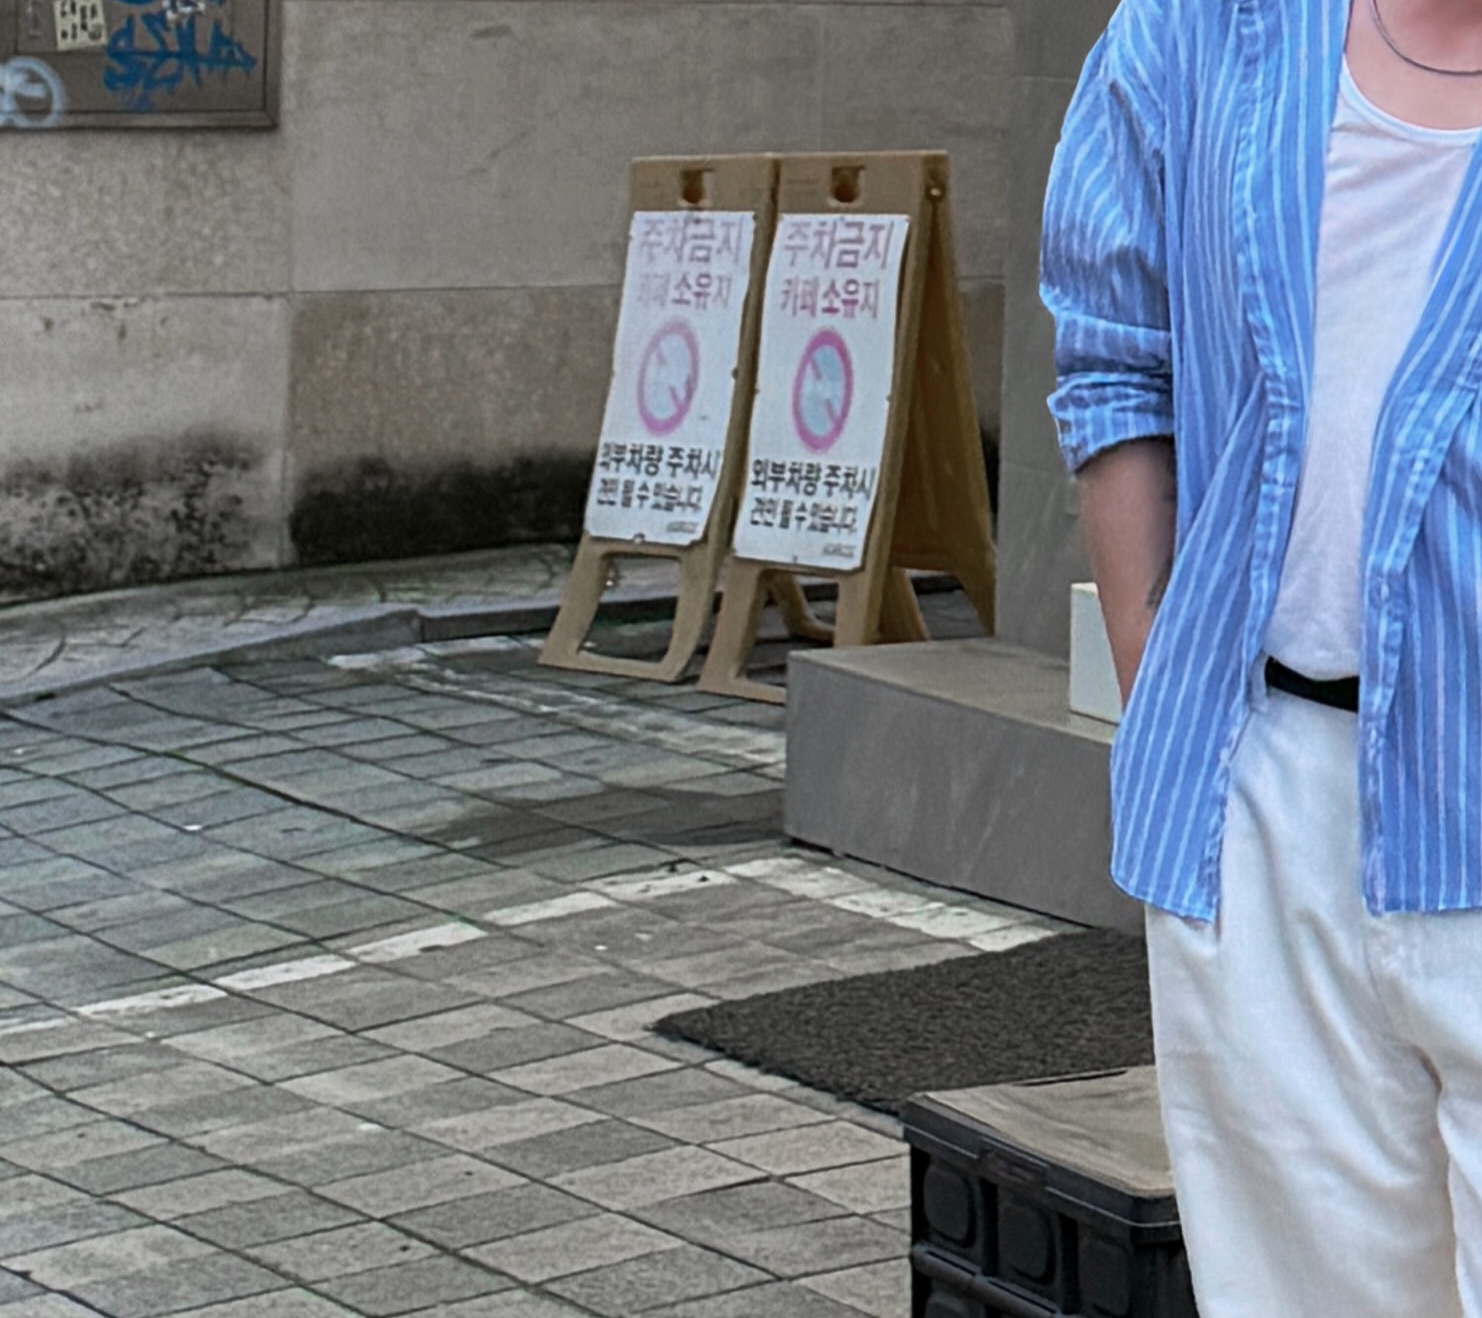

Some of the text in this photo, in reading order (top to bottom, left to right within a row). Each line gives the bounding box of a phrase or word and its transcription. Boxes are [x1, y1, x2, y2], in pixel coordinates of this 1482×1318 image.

[638, 216, 744, 265] 주차금지
[783, 219, 895, 271] 주차금지
[750, 458, 822, 498] 외부차량
